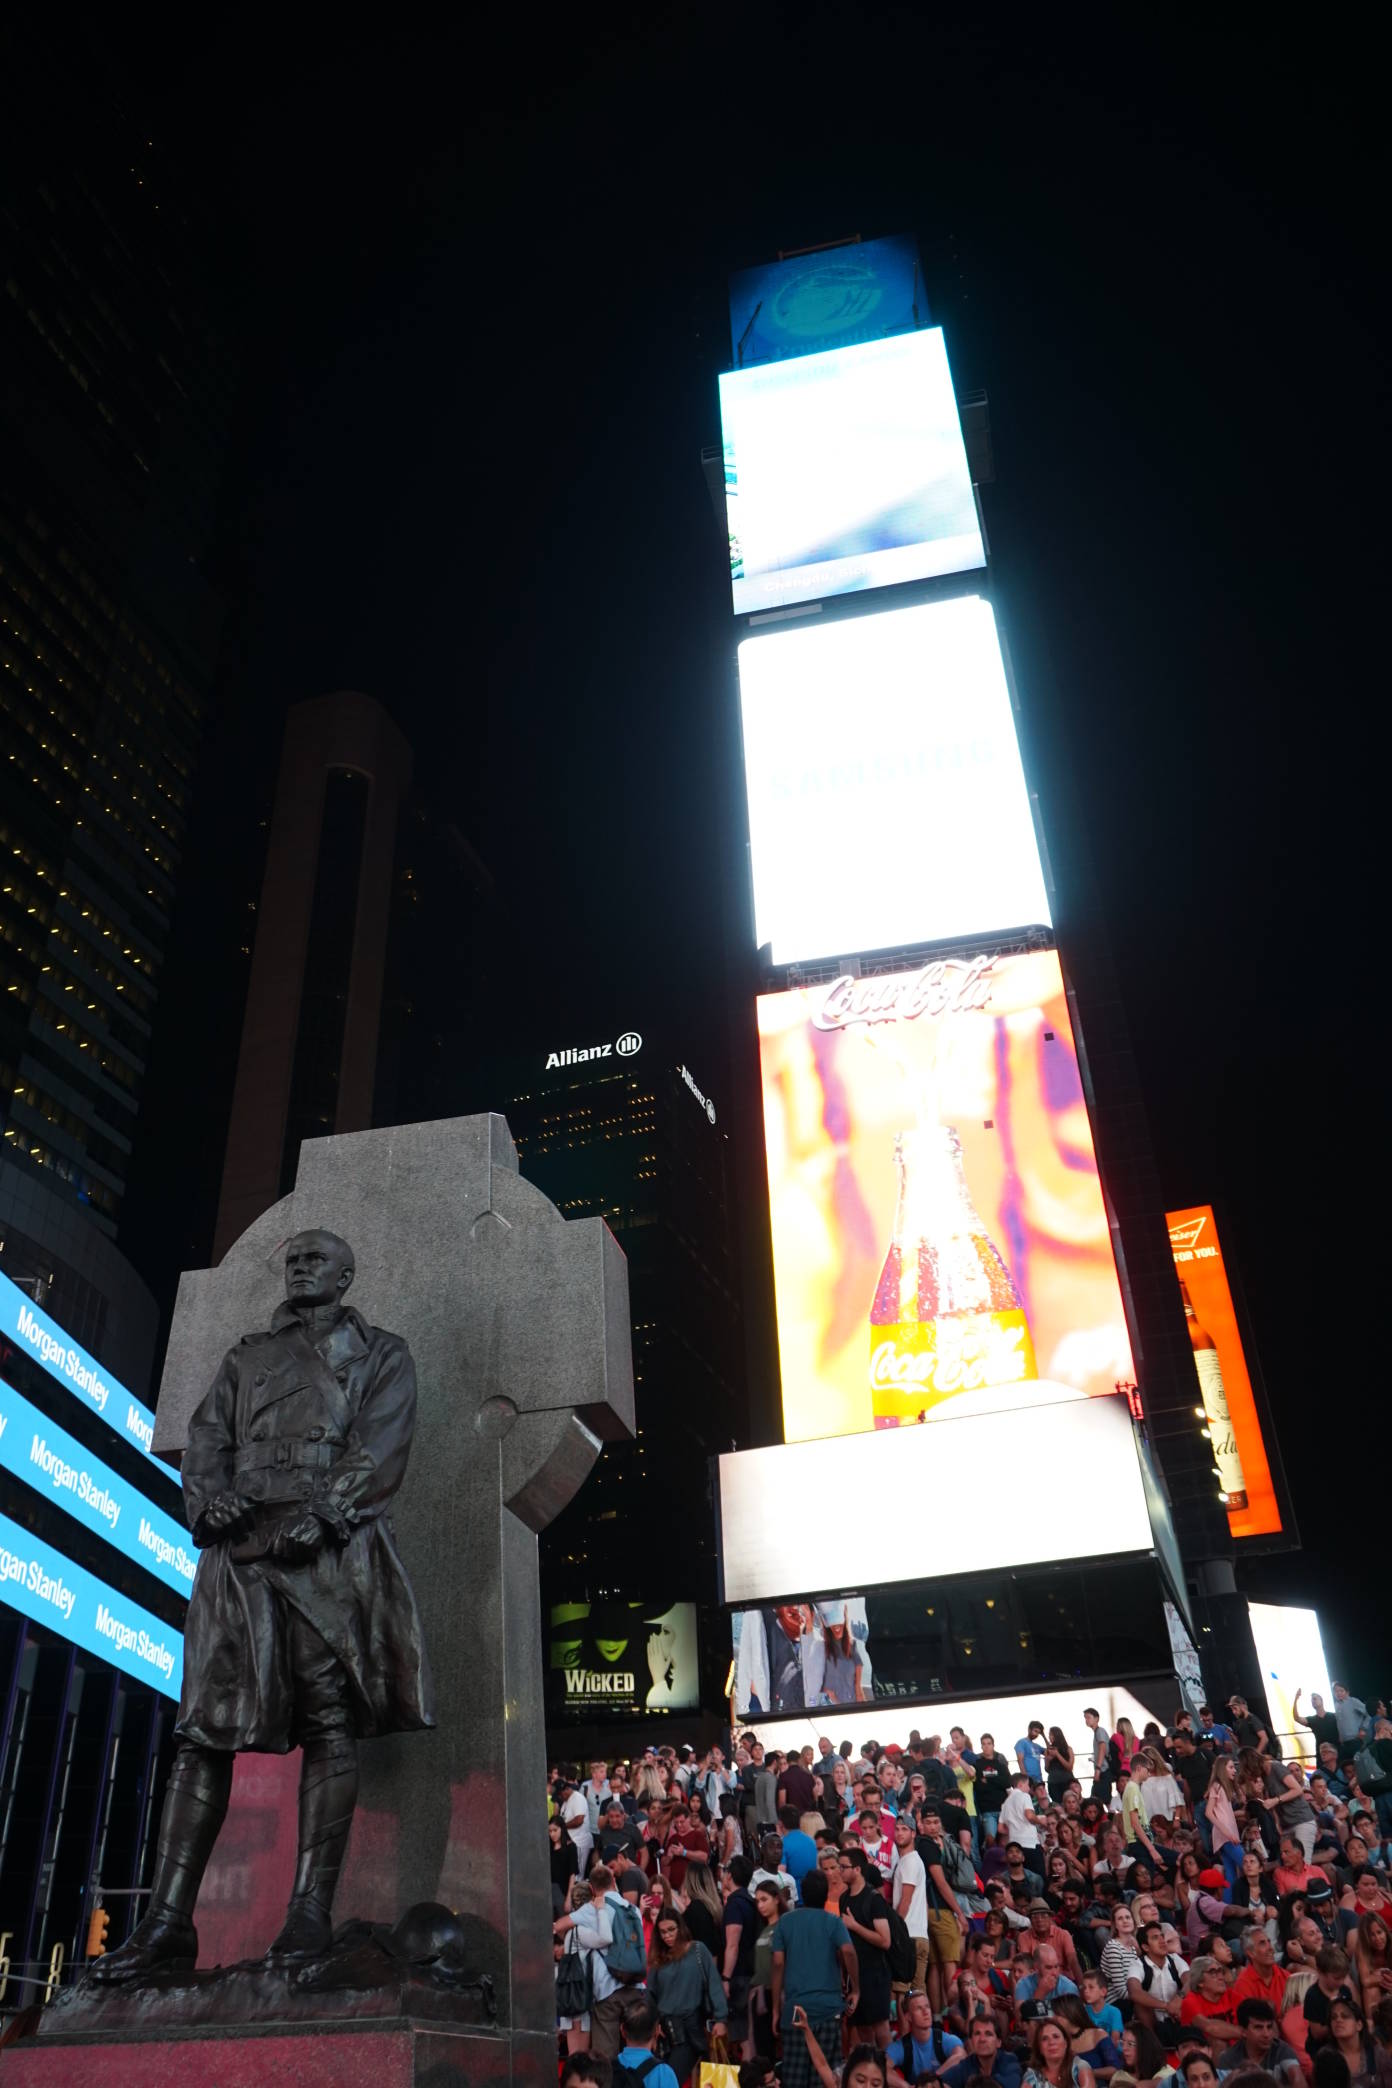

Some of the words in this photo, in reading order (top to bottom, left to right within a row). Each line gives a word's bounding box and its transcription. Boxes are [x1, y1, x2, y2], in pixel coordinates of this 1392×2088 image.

[545, 1044, 612, 1070] Allianz
[17, 1305, 66, 1369] Morgan
[65, 1350, 109, 1411] Stanley
[126, 1405, 153, 1452] Morg
[30, 1434, 78, 1493] Morgan
[77, 1471, 121, 1529] Stanley
[138, 1518, 176, 1566] Morgan
[175, 1547, 197, 1582] Stan
[27, 1560, 76, 1620] Stanley
[95, 1603, 138, 1653] Morgan
[137, 1629, 175, 1679] Stanley
